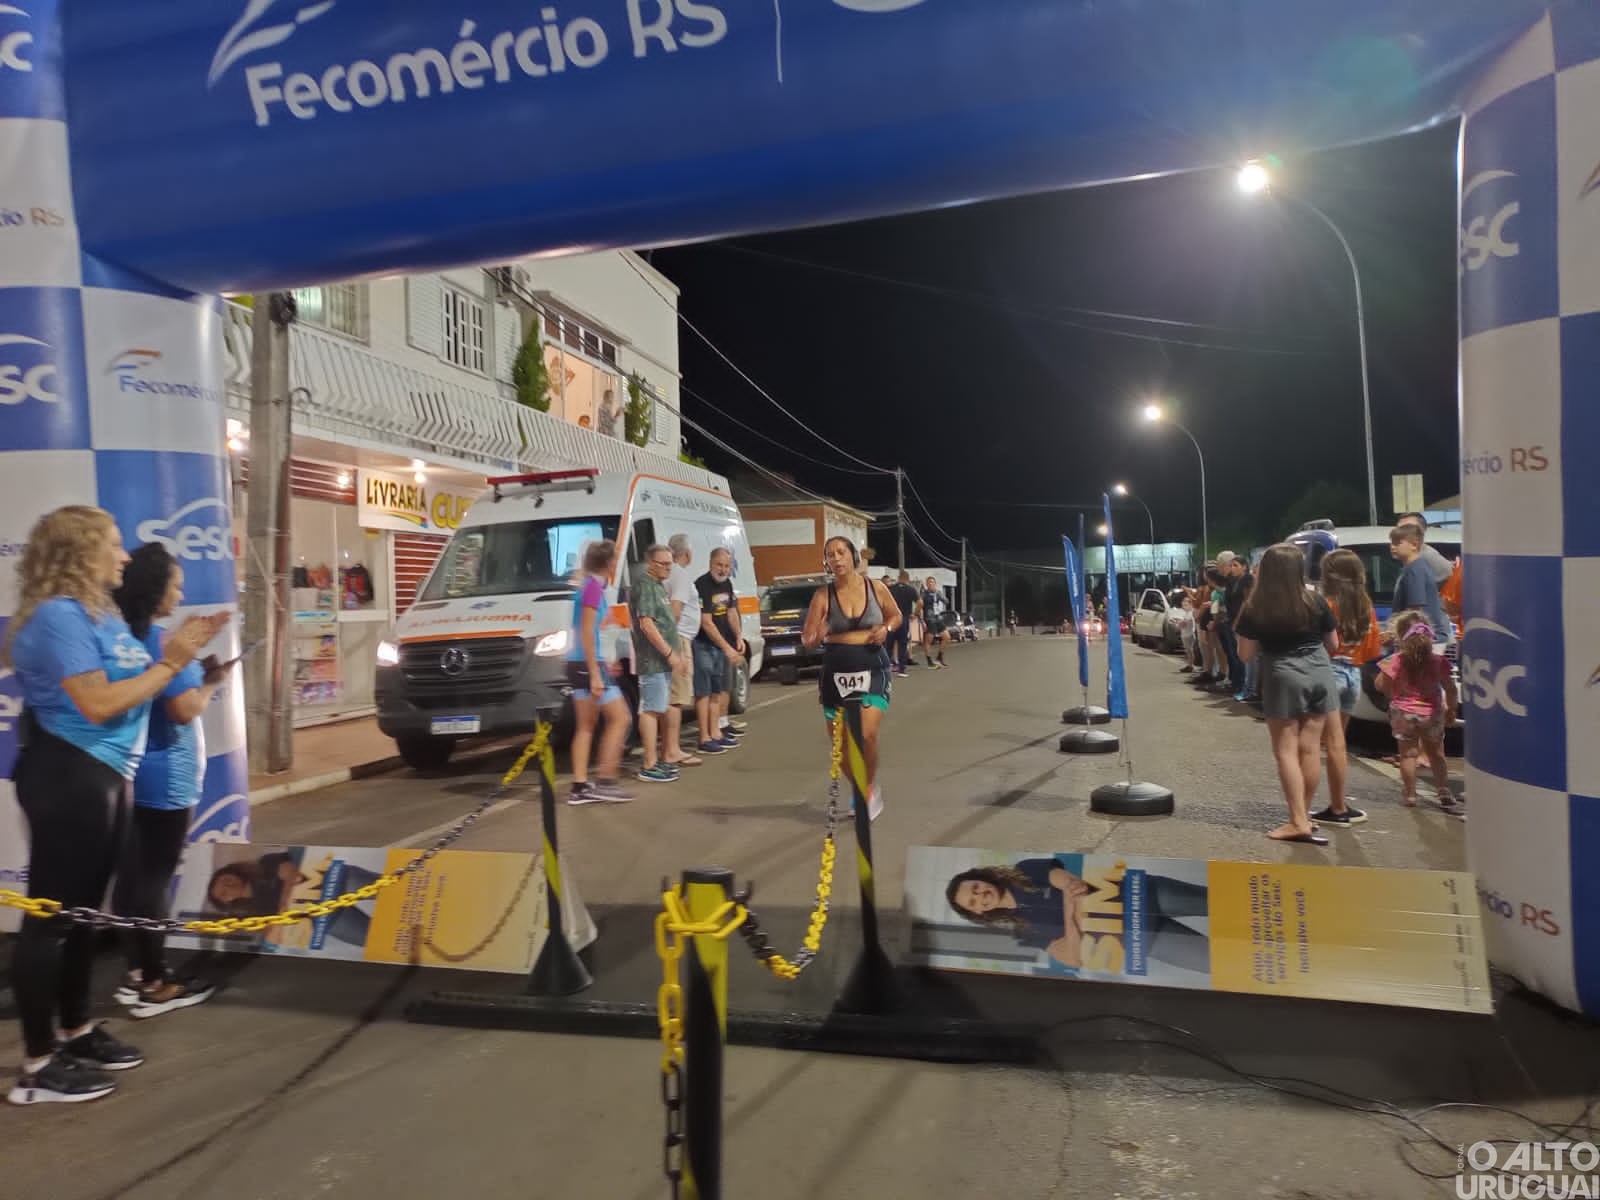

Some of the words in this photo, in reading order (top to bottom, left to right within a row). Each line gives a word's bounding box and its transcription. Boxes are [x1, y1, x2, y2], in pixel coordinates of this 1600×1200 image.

[245, 7, 609, 126] Fecomércio
[625, 0, 728, 57] RS
[30, 207, 65, 227] RS
[1510, 445, 1549, 472] RS
[837, 674, 865, 691] 941
[1520, 902, 1561, 937] RS
